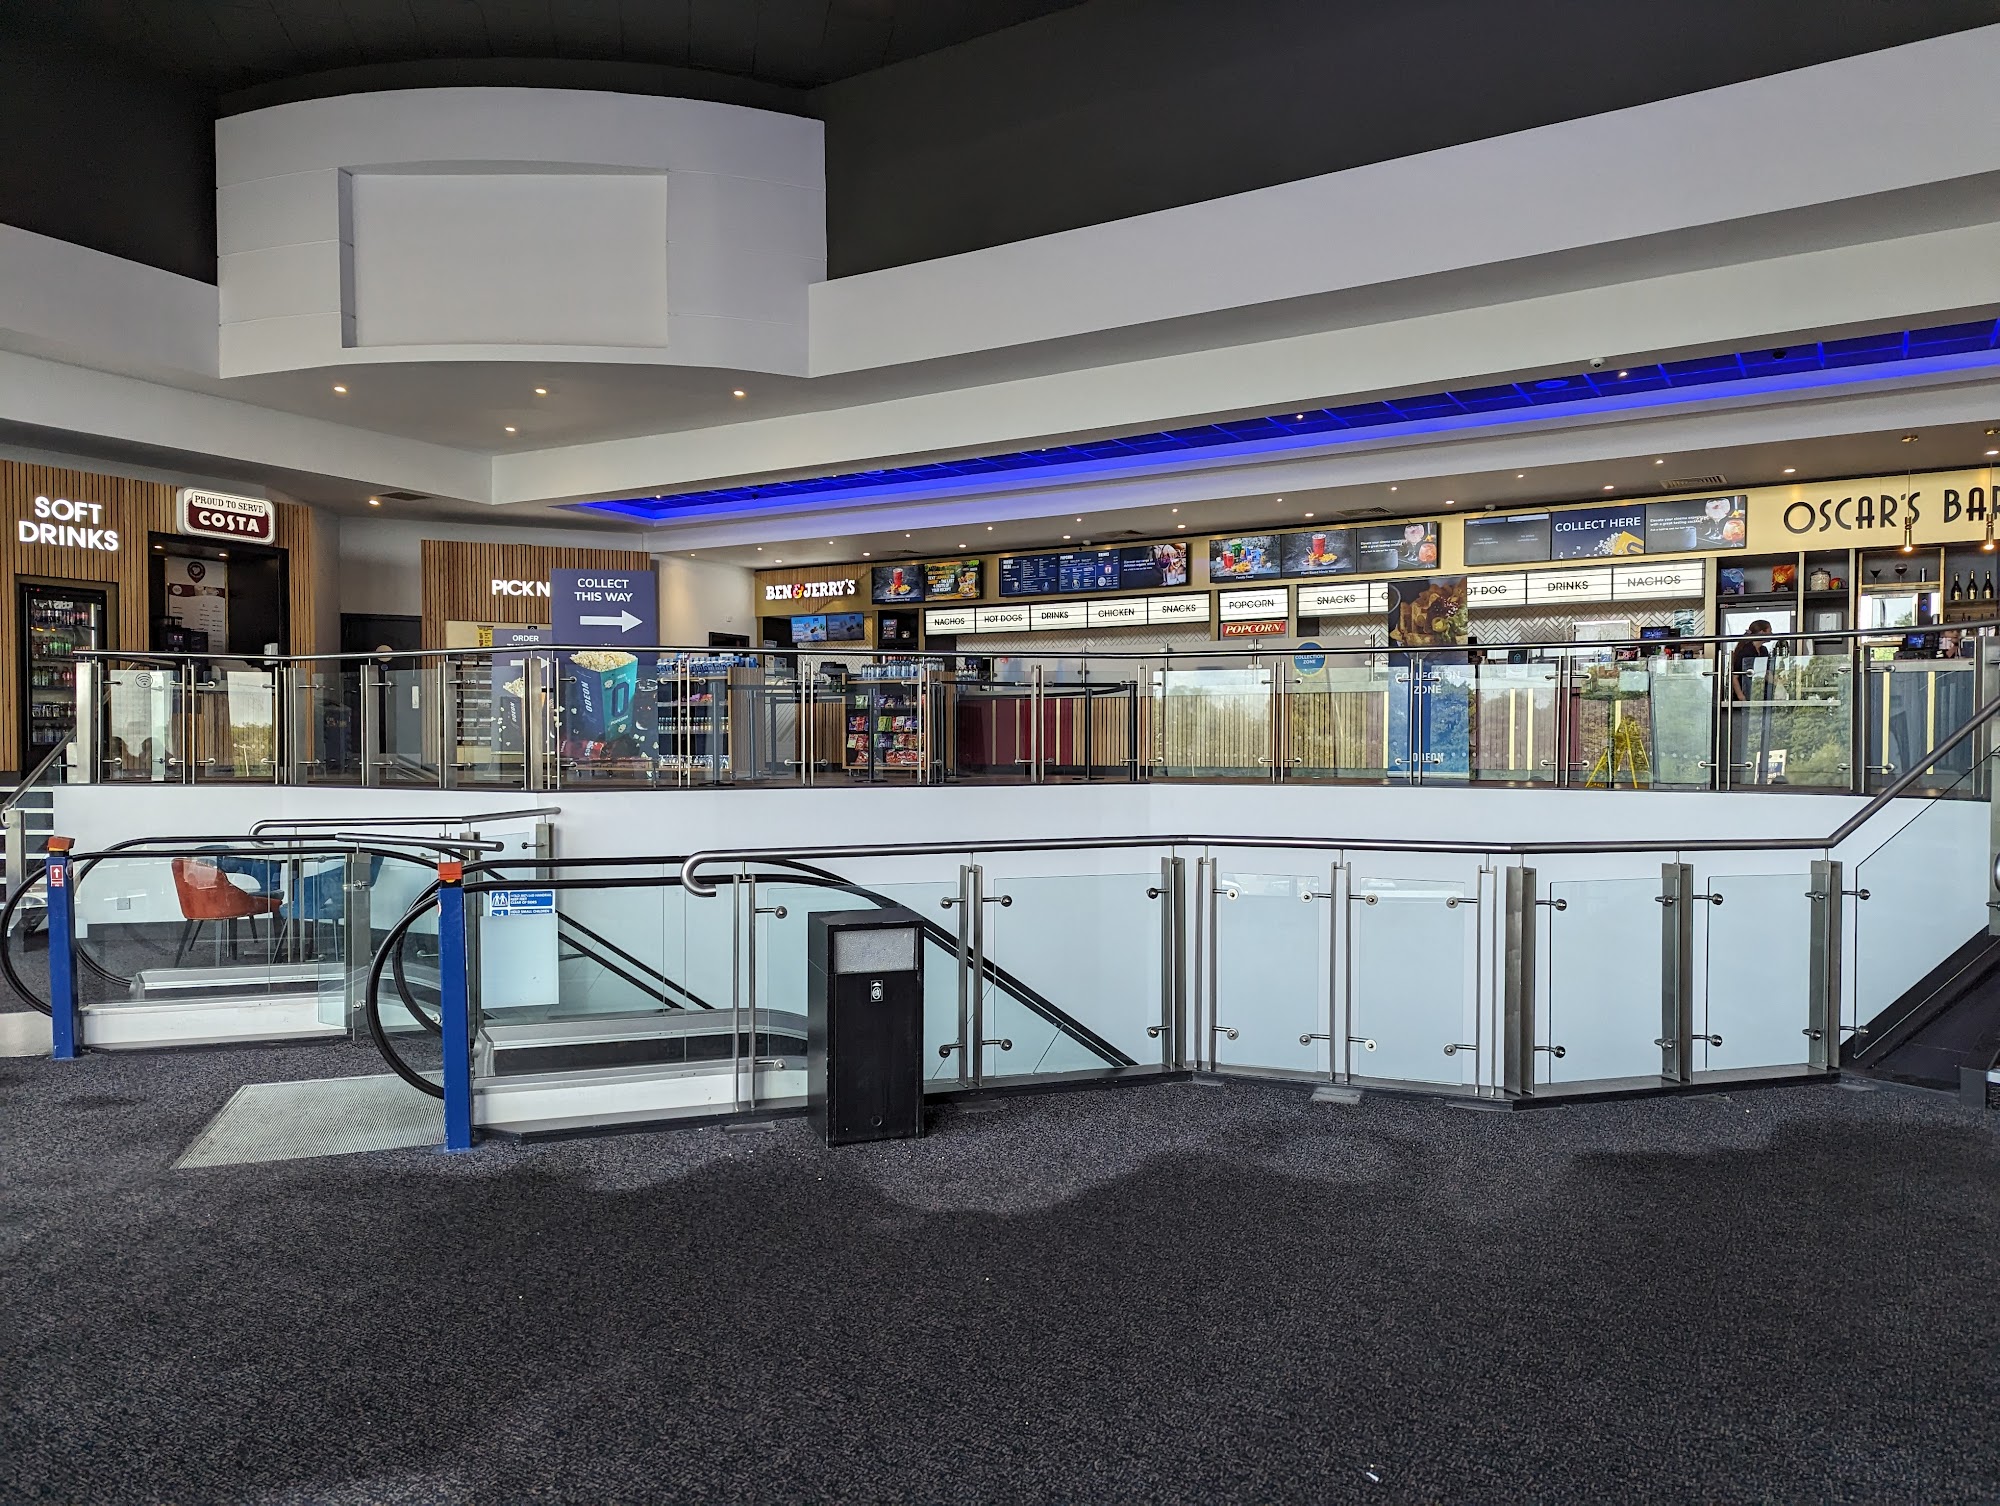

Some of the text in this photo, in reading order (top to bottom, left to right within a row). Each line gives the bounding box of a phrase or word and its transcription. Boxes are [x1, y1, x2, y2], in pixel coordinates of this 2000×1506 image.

[34, 495, 103, 525] SOFT
[194, 495, 264, 514] PROUD TO SERVE
[1783, 491, 1921, 535] OSCAR'S
[198, 510, 260, 533] COSTA
[1555, 516, 1641, 533] COLLECT HERE
[18, 520, 119, 551] DRINKS
[577, 578, 630, 589] COLLECT
[1547, 580, 1589, 592] DRINKS
[1627, 575, 1681, 587] NACHOS
[491, 579, 550, 597] PICK N
[1481, 584, 1507, 595] DOG
[574, 591, 633, 602] THIS WAY
[1316, 594, 1356, 605] SNACKS
[1161, 604, 1197, 614] SNACKS
[1229, 599, 1274, 609] POPCORN
[984, 614, 1023, 623] HOT DOGS
[1041, 611, 1069, 620] DRINKS
[1098, 608, 1135, 618] CHICKEN
[934, 617, 965, 626] NACHOS
[1225, 623, 1281, 635] POPCORN
[512, 634, 539, 642] ORDER
[580, 680, 593, 713] ODEON
